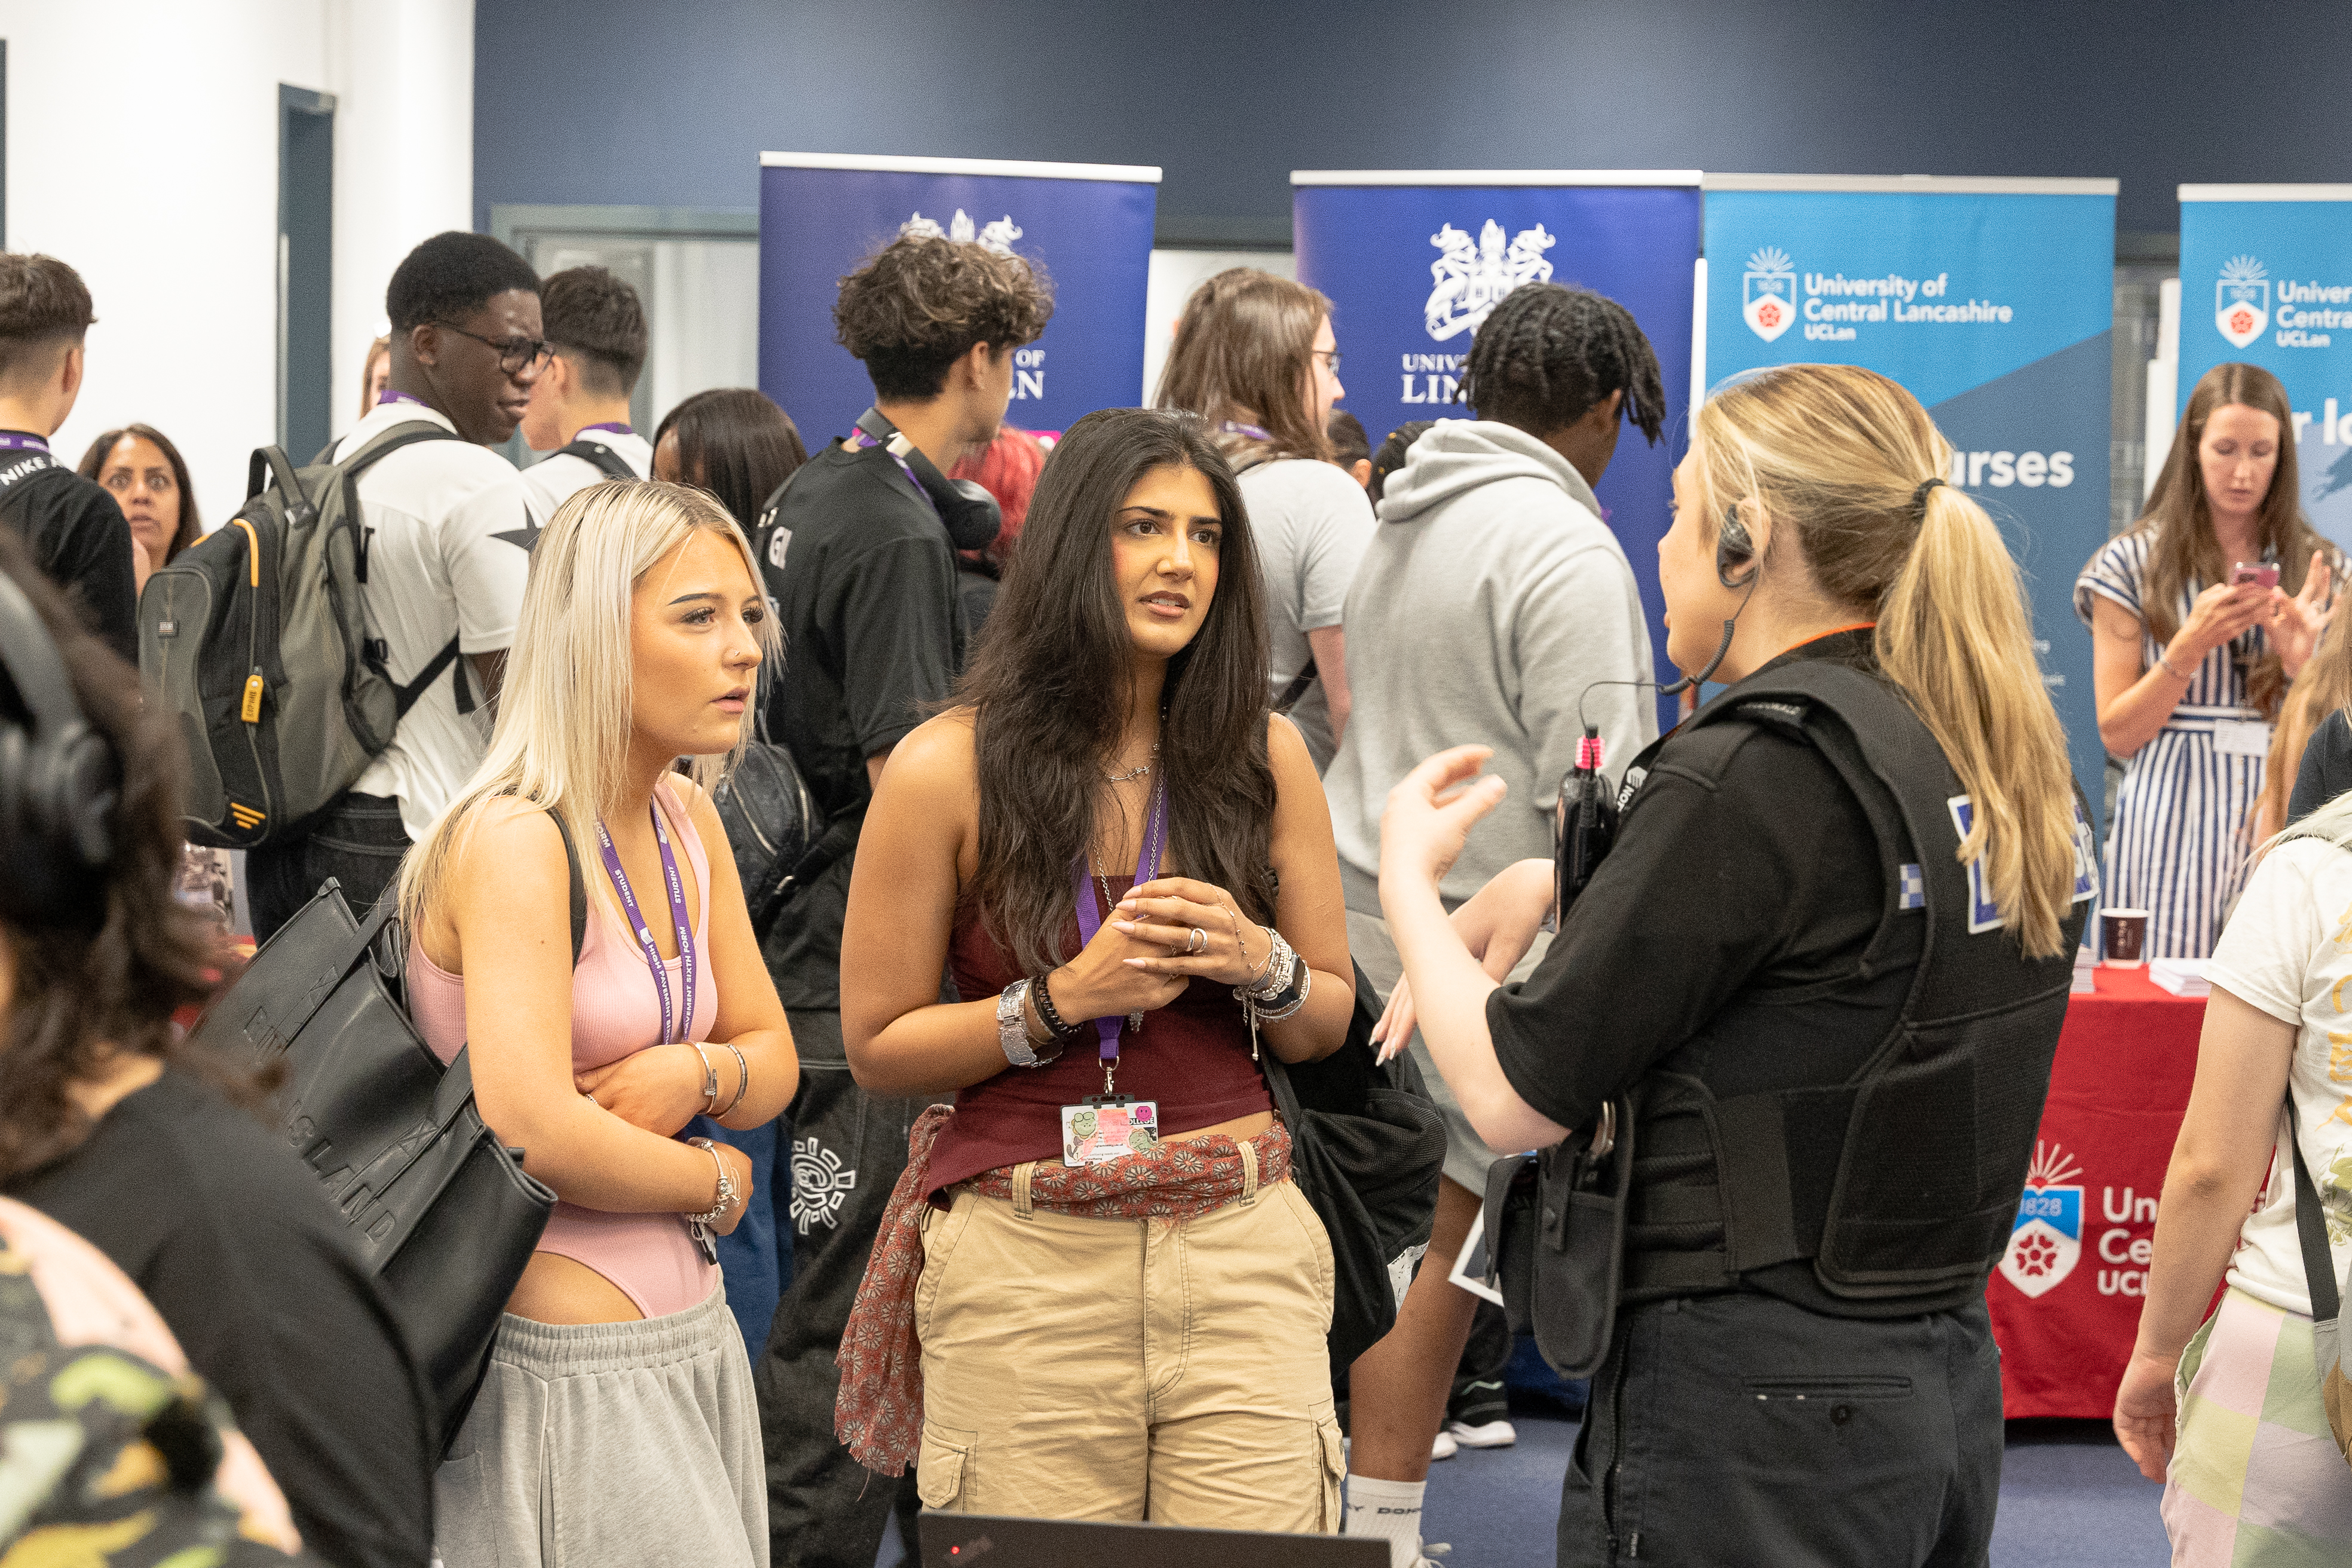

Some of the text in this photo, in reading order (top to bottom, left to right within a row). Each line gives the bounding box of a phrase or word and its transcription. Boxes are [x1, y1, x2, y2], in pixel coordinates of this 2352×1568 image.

[1803, 272, 1949, 302] University of
[1803, 298, 2013, 323] Central Lancashire
[1803, 323, 1856, 341] UCLan
[1015, 349, 1046, 368] OF
[0, 456, 47, 486] NIKE
[614, 869, 634, 908] STUDENT
[667, 865, 681, 904] STUDENT
[679, 926, 691, 954] FORM
[648, 944, 663, 971] HIGH
[659, 970, 671, 1018] PAVEMENT
